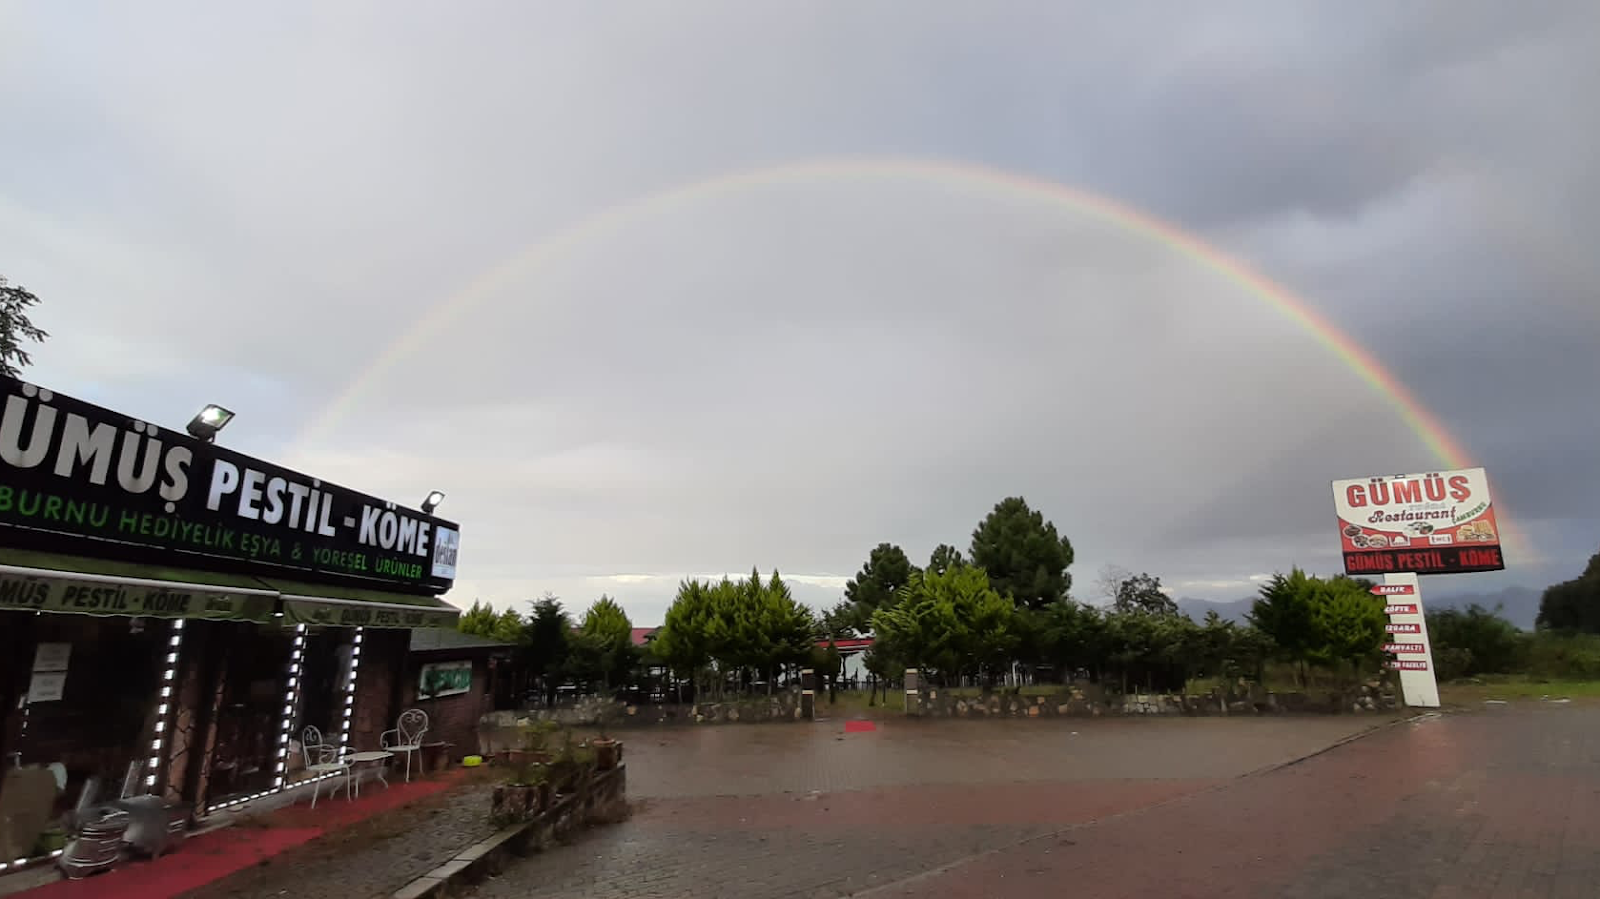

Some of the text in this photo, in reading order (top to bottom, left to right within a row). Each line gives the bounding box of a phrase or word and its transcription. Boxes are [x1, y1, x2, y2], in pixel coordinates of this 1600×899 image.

[1346, 473, 1471, 508] GÜMÜŞ
[207, 458, 336, 537] PESTİL
[358, 501, 431, 557] KÖME
[1368, 506, 1456, 523] Restaurant
[118, 510, 235, 550] HEDİYELİK
[1397, 550, 1446, 569] PESTİL
[1459, 548, 1500, 567] KÖME
[61, 584, 128, 609] PESTİL
